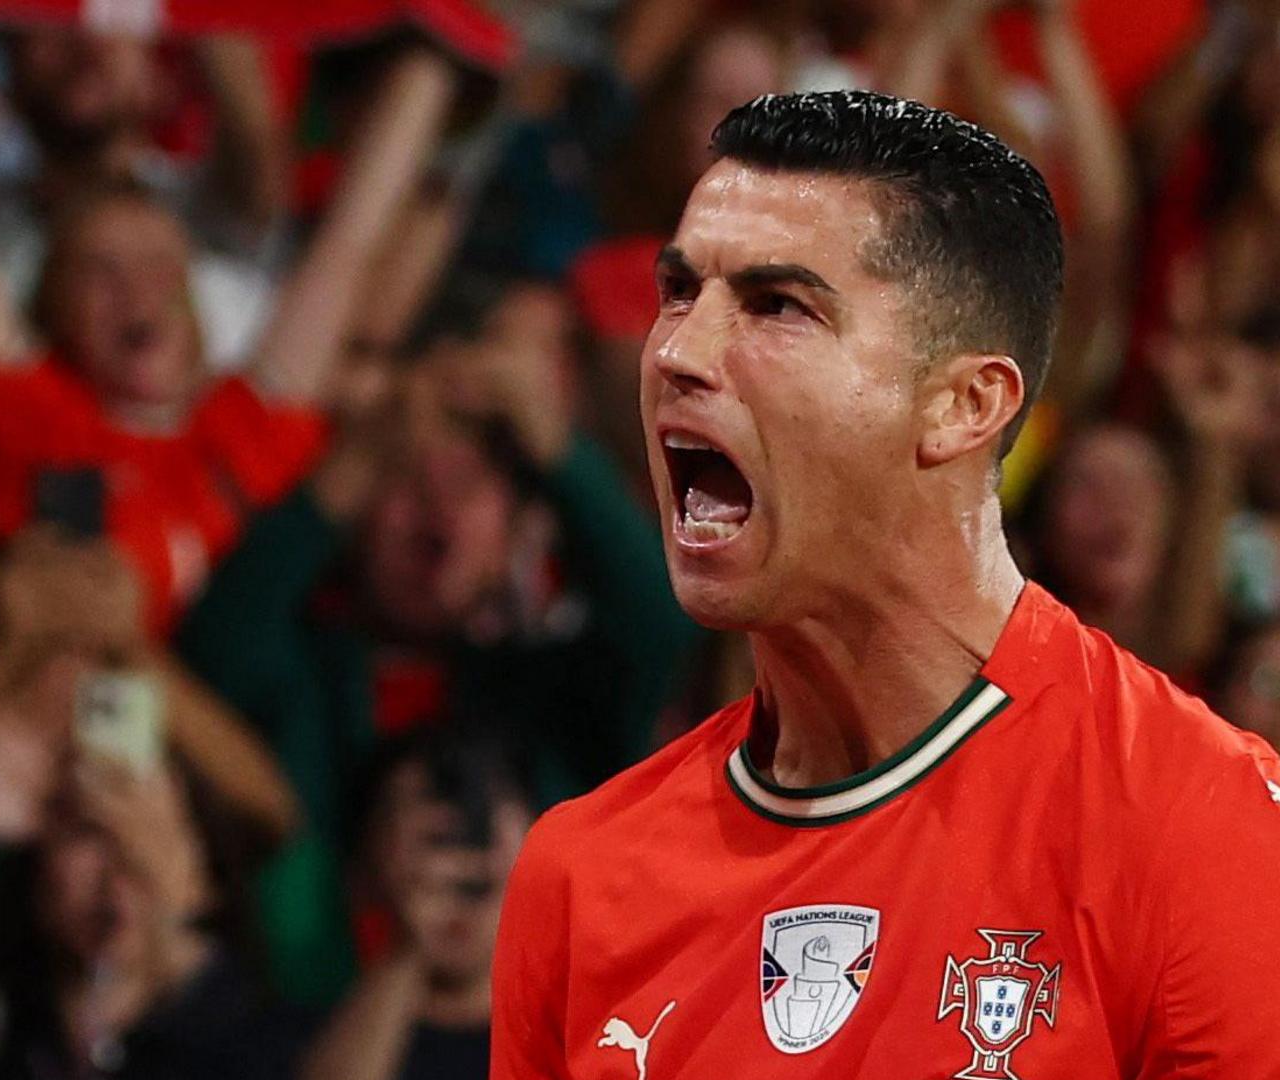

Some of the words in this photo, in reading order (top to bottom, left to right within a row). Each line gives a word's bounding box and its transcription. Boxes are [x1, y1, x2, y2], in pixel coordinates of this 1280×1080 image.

[769, 916, 795, 928] UEFA
[796, 911, 837, 922] NATIONS
[839, 911, 875, 924] LEAGUE
